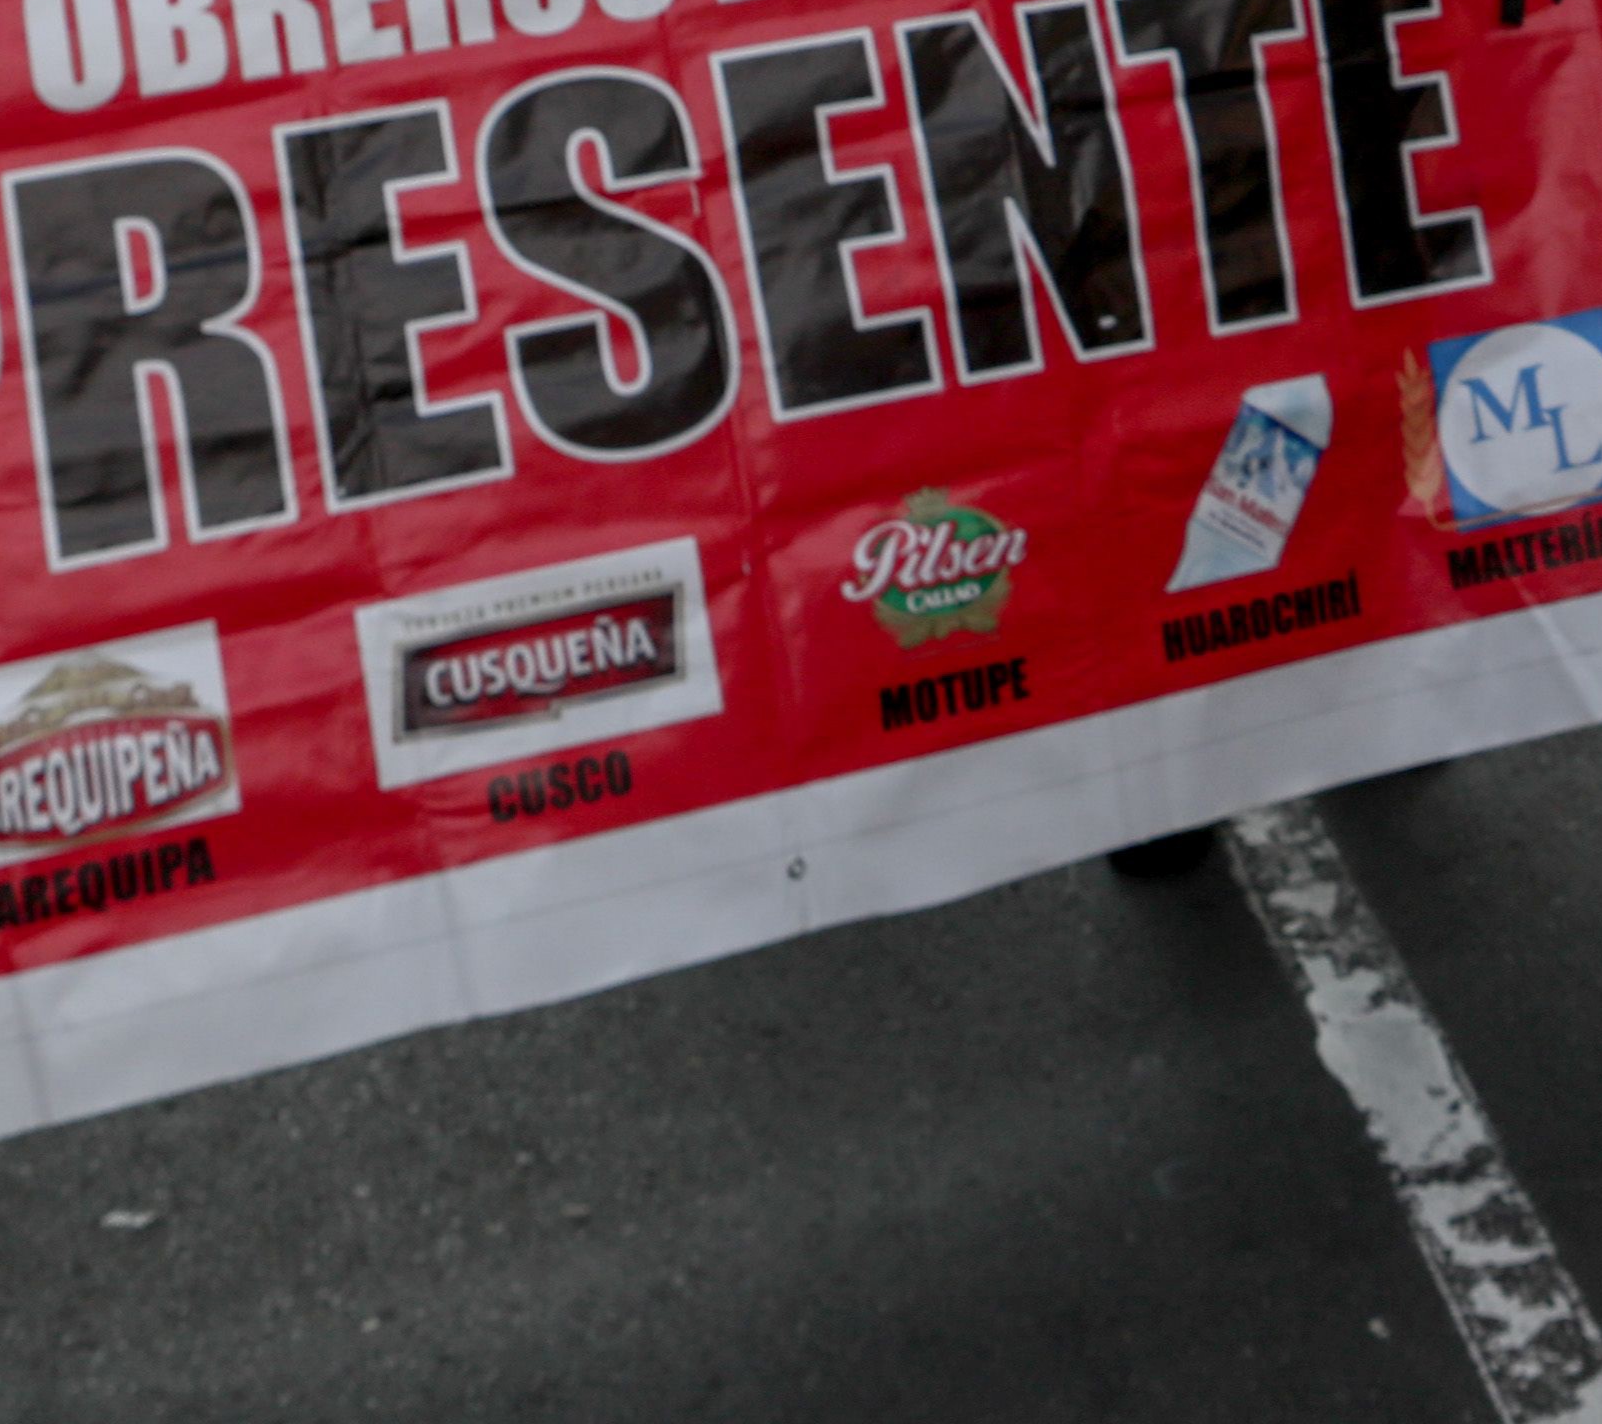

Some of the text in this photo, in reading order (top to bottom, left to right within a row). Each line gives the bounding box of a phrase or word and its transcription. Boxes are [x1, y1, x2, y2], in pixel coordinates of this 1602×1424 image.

[840, 519, 1029, 601] Pilsen
[1162, 569, 1362, 661] HUAROCHIRÍ
[425, 616, 658, 709] CUSQUEÑA
[879, 658, 1031, 730] MOTUPE
[487, 752, 633, 824] CUSCO
